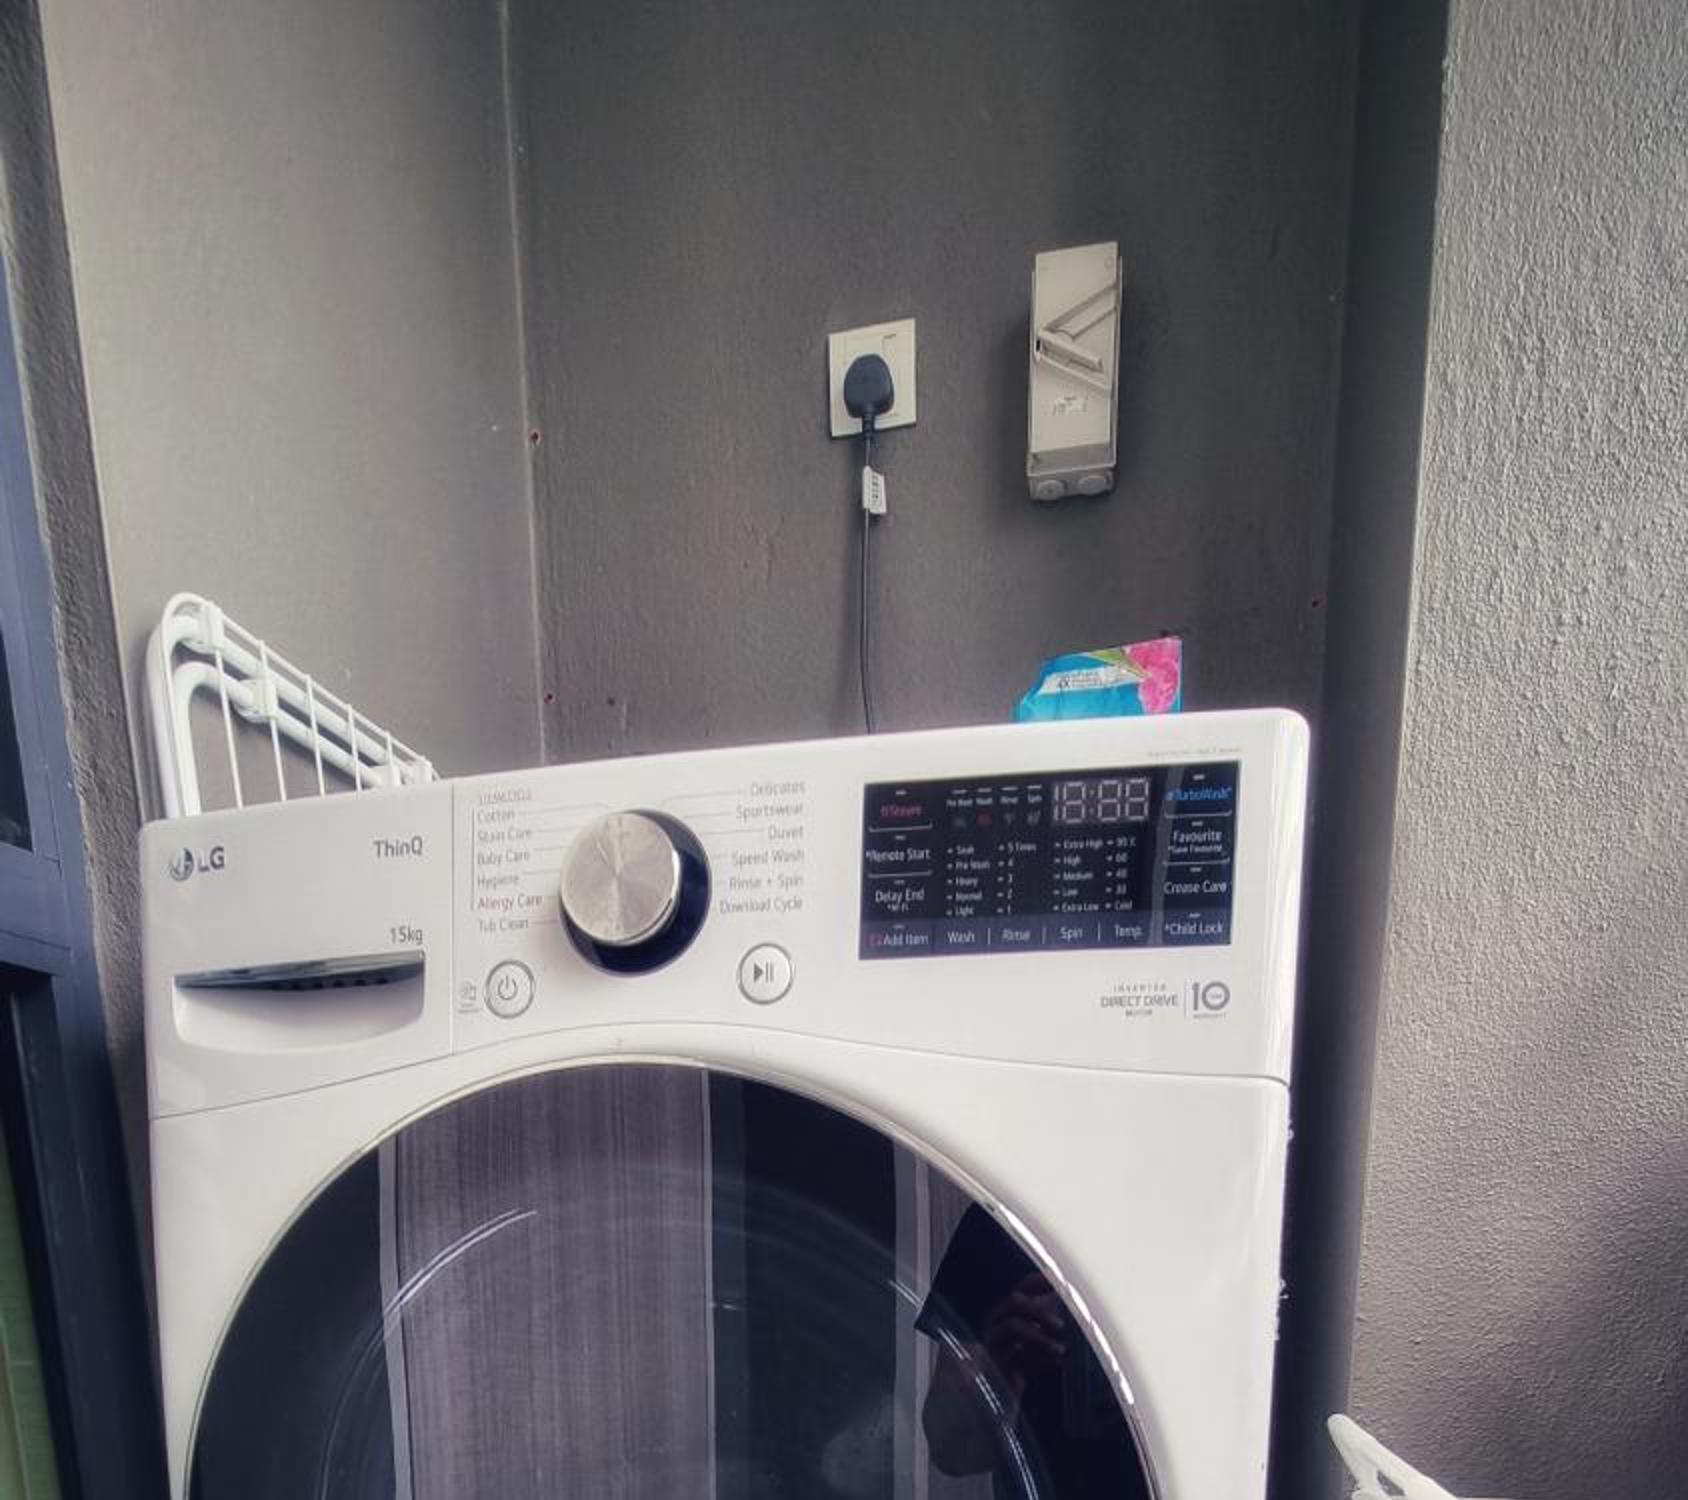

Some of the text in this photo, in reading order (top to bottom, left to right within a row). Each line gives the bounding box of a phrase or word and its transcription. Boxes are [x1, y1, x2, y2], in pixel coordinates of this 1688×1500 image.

[477, 808, 516, 822] Cotton
[736, 802, 803, 824] Sportswear
[507, 827, 532, 841] Care
[1173, 830, 1222, 844] Favourite
[374, 836, 423, 860] ThinQ
[506, 849, 530, 862] Care
[907, 847, 931, 861] Start
[197, 846, 226, 871] LG
[732, 847, 804, 869] Speed Wash
[1163, 880, 1227, 895] Crease Care
[477, 893, 543, 912] Allergy Care
[875, 888, 925, 904] Delay End
[720, 895, 803, 915] Download Cycle
[1060, 926, 1083, 942] Spin
[1199, 919, 1224, 934] Lock
[390, 925, 423, 945] 15kg
[883, 932, 929, 946] Add Item
[947, 930, 975, 943] Wash
[1100, 993, 1179, 1008] DIRECT DRIVE
[1191, 981, 1231, 1011] 10
